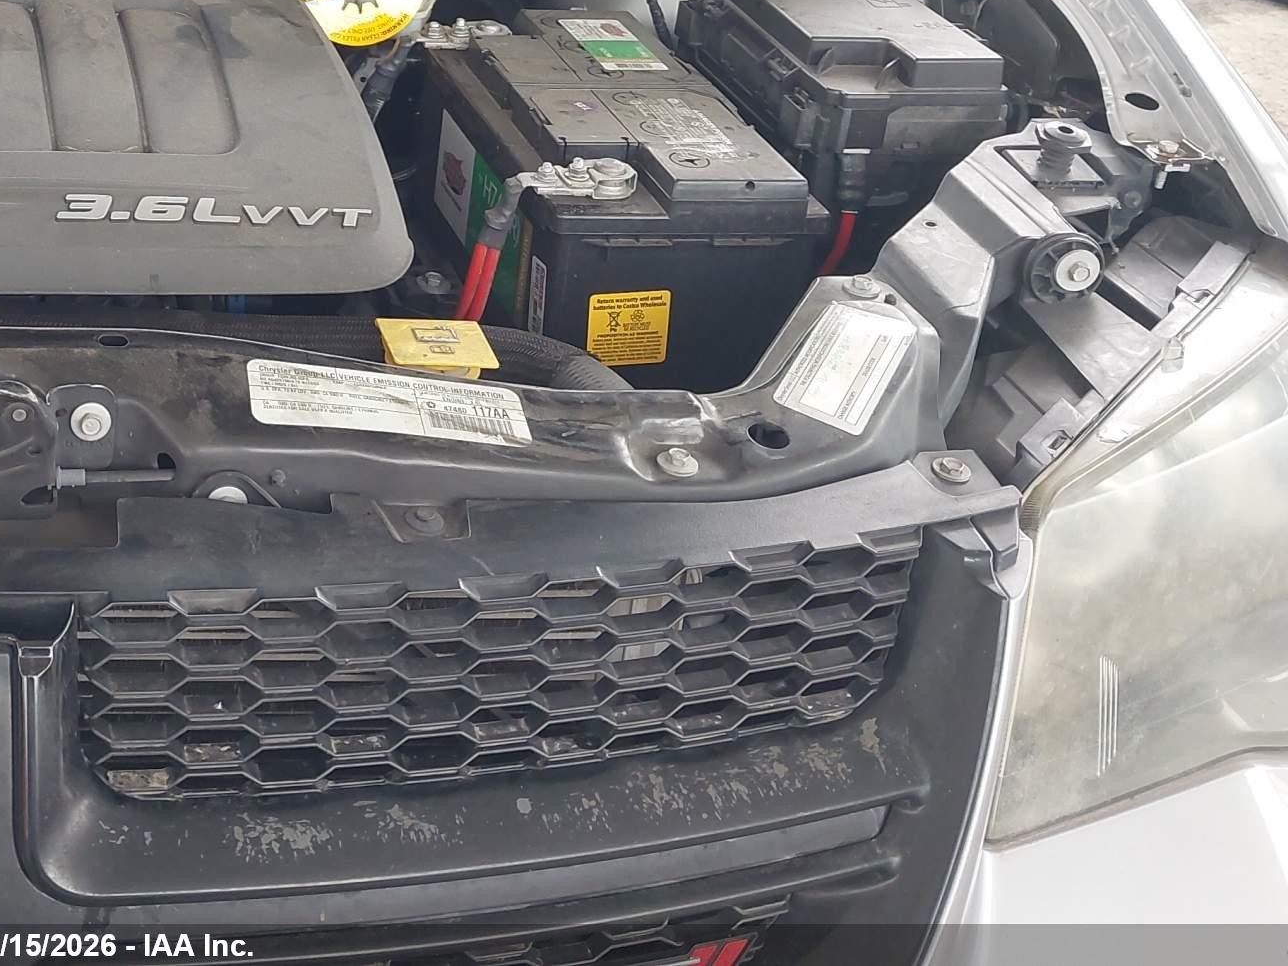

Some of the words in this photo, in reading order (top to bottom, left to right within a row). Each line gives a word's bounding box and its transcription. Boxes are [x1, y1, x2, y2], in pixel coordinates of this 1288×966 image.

[56, 193, 241, 224] 3.6L
[242, 204, 372, 227] VVT
[259, 365, 291, 374] Chrysler
[338, 373, 372, 383] VEHICLE
[373, 378, 410, 388] EMISSION
[413, 384, 448, 393] CONTROL
[450, 387, 505, 400] INFORMATION
[472, 405, 510, 419] 117AA
